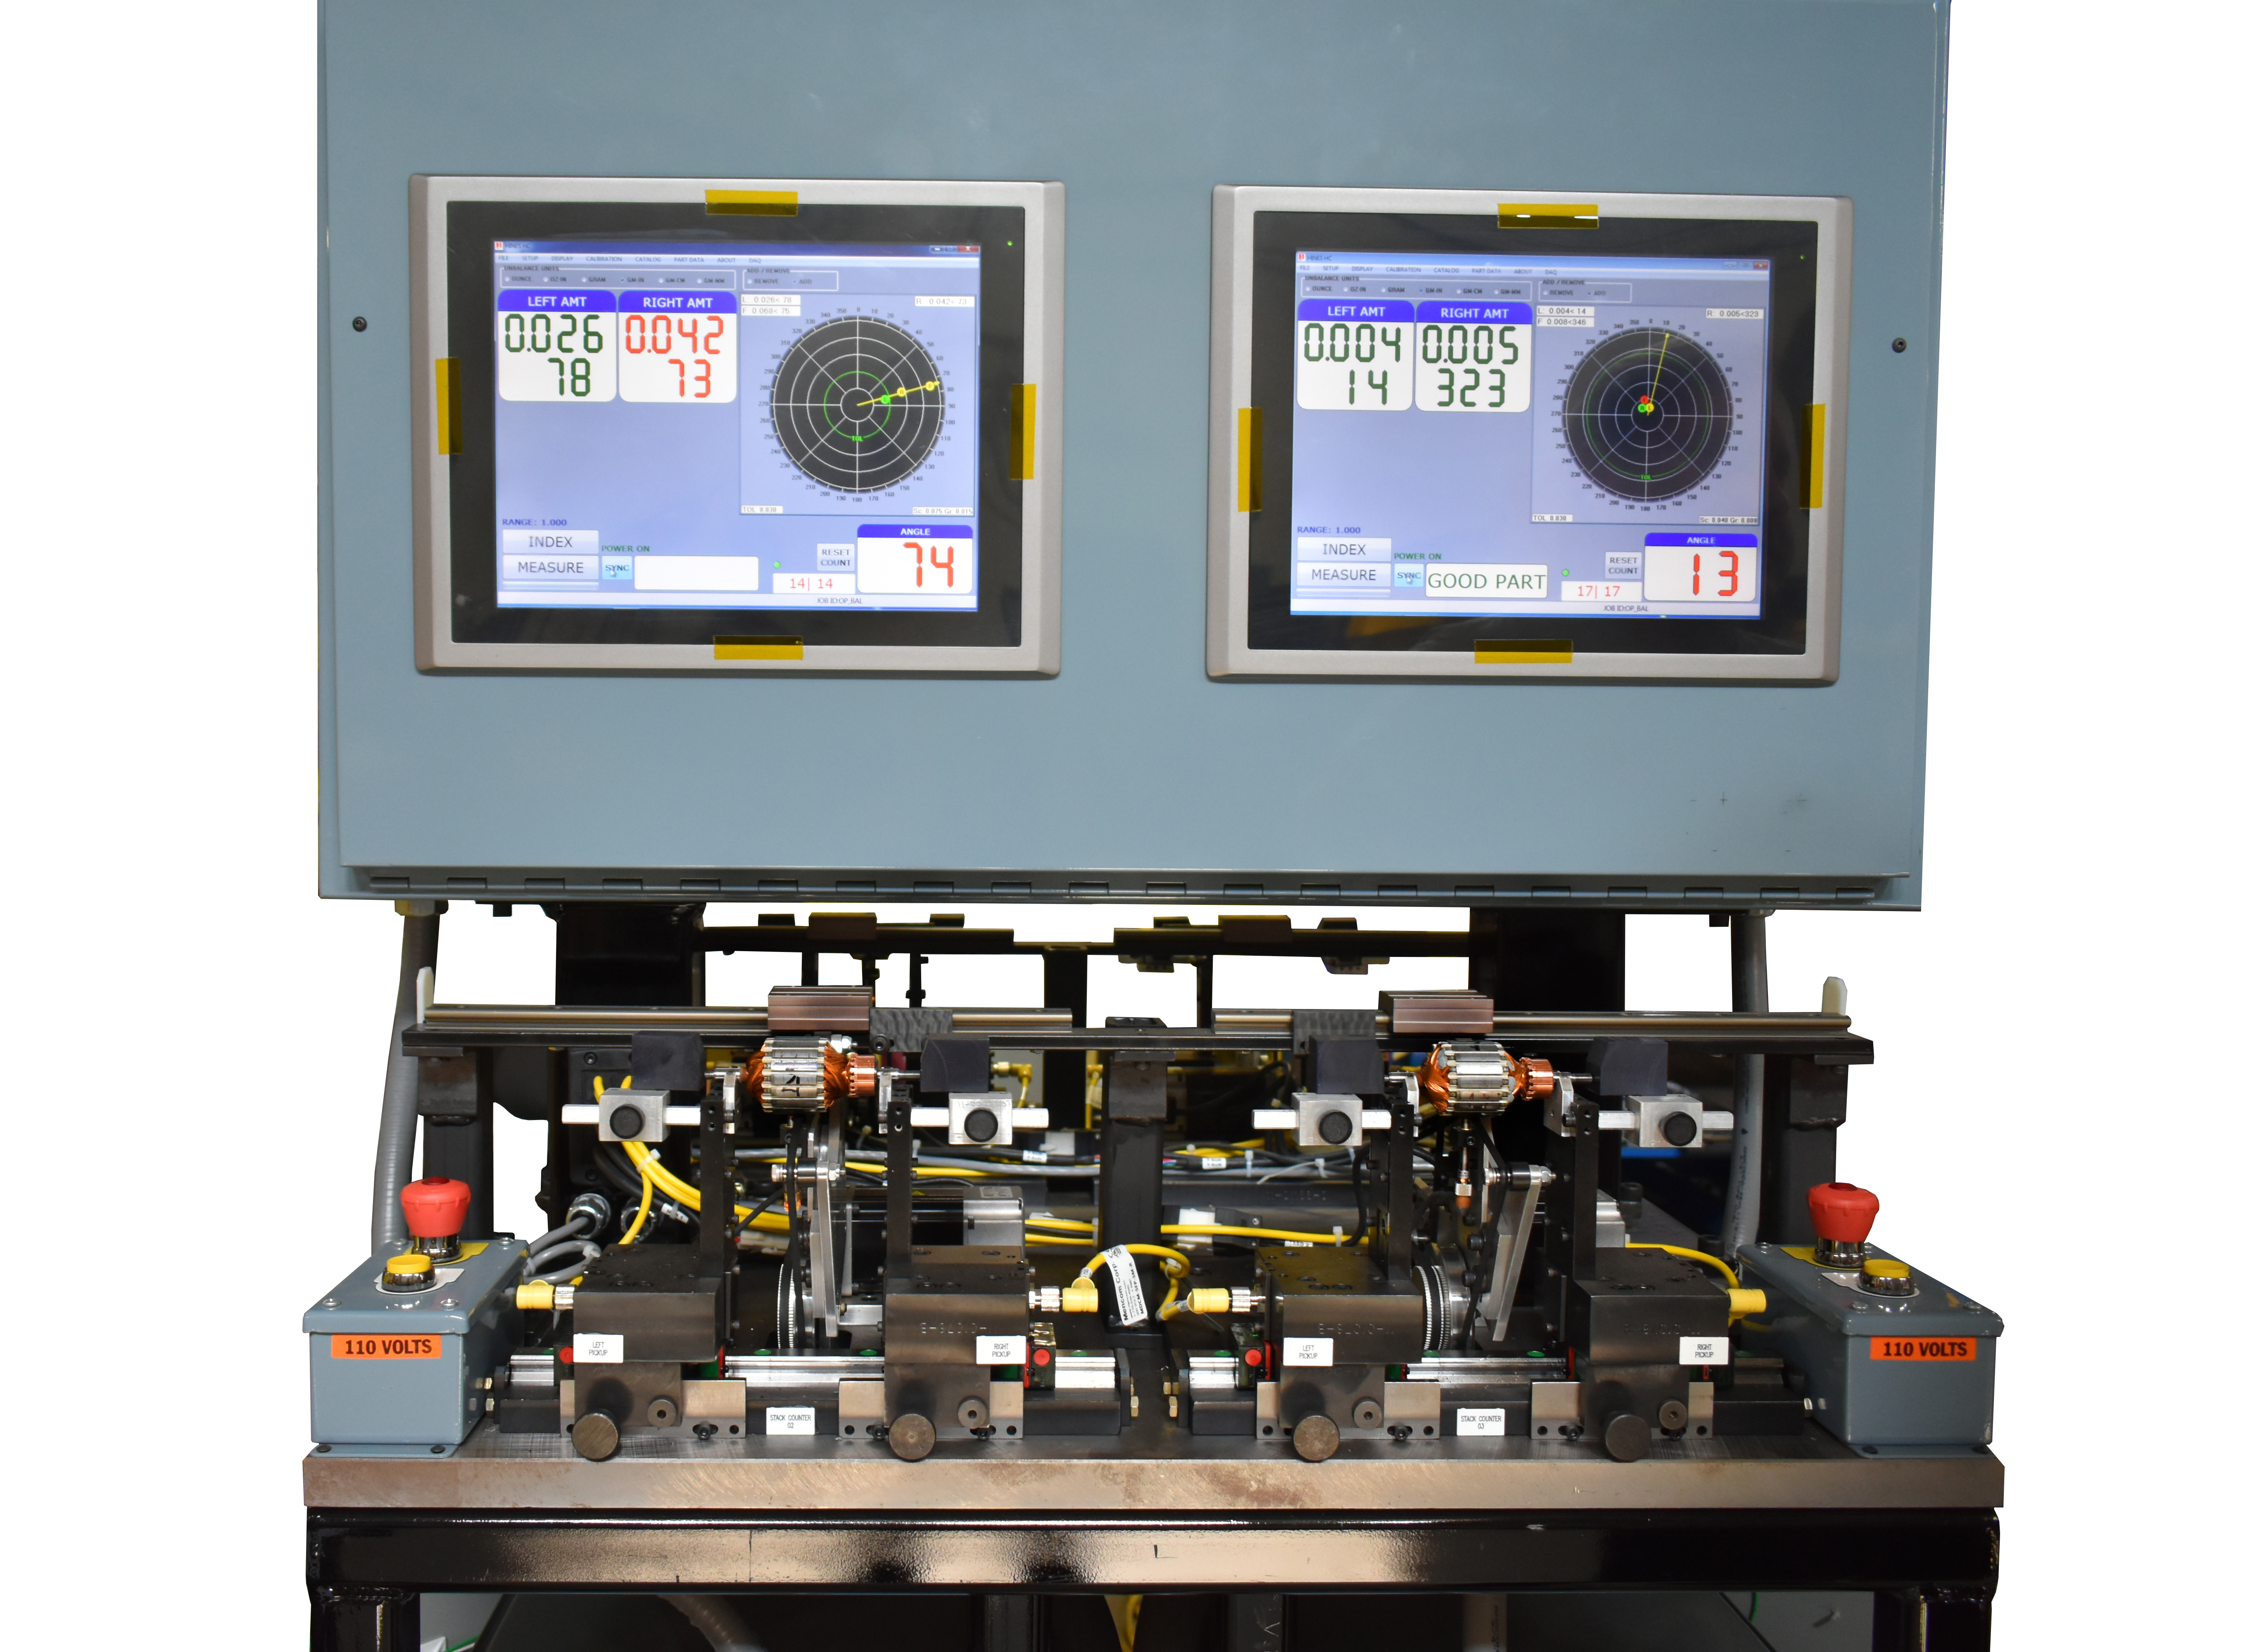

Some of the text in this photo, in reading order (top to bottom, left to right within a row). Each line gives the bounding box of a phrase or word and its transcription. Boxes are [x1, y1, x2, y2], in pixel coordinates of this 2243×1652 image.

[528, 296, 587, 307] LEFT AMT
[643, 297, 713, 308] RIGHT AMT
[1328, 306, 1386, 316] LEFT AMT
[1441, 308, 1509, 319] RIGHT AMT
[505, 313, 603, 353] 0.026
[625, 314, 724, 354] 0.042
[1304, 323, 1401, 363] 0.004
[1422, 325, 1518, 365] 0.005
[548, 357, 591, 397] 78
[668, 358, 711, 398] 73
[1349, 369, 1388, 406] 14
[1437, 368, 1506, 408] 323
[529, 536, 573, 548] INDEX
[1323, 544, 1366, 555] INDEX
[518, 562, 584, 573] MEASURE
[903, 542, 954, 588] 74
[1312, 569, 1376, 581] MEASURE
[1428, 573, 1546, 589] GOOD PART
[1693, 551, 1738, 596] 13
[817, 578, 833, 589] 14
[1604, 586, 1620, 597] 17
[1119, 1285, 1129, 1321] Mencom
[345, 1339, 432, 1355] 110 VOLTS
[1883, 1341, 1967, 1357] 110 VOLTS
